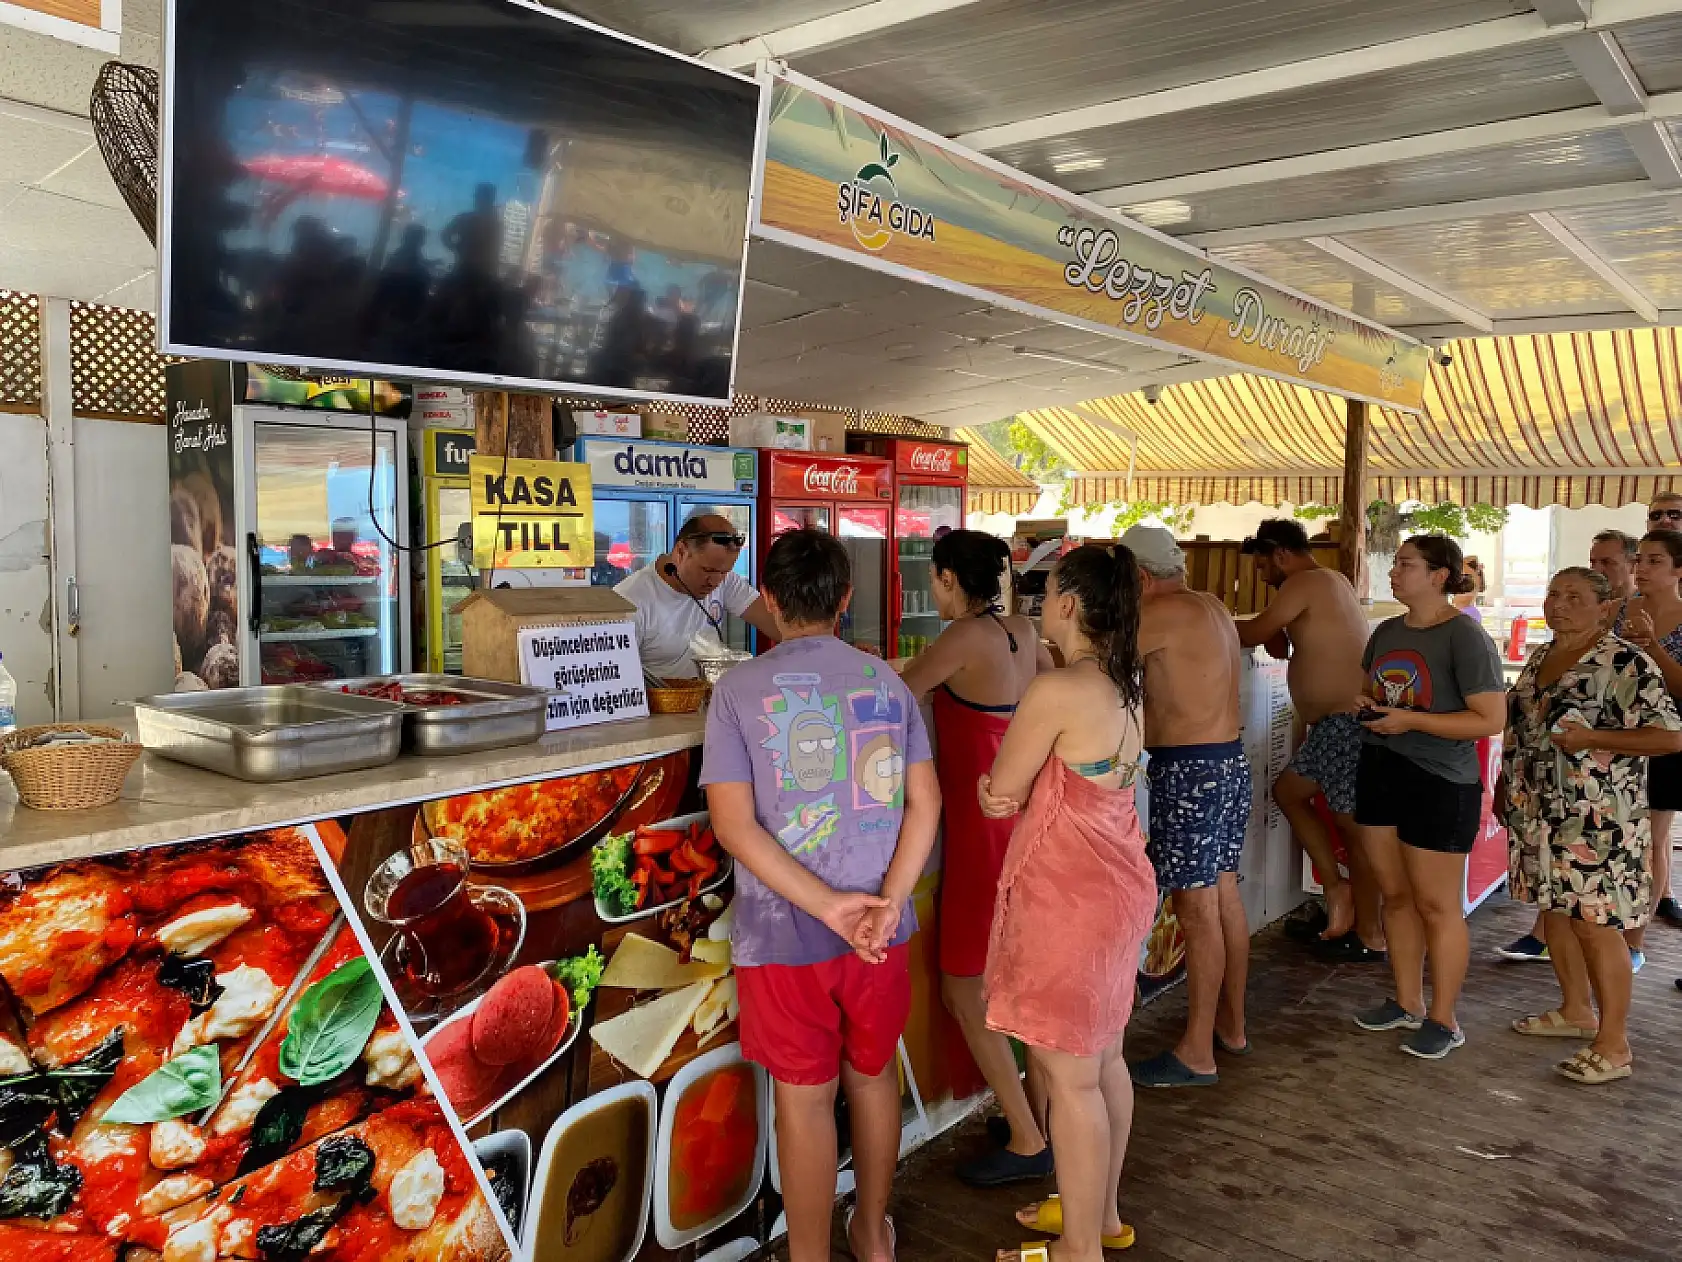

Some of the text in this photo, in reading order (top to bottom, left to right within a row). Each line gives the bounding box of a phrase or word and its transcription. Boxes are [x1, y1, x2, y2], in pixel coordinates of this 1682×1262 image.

[838, 182, 936, 241] ŞİFA GIDA
[614, 444, 708, 479] damla
[484, 474, 577, 507] KASA
[497, 522, 571, 551] TILL
[531, 631, 631, 661] Düşünceleriniz ve
[553, 660, 621, 691] görüşleriniz
[569, 694, 592, 720] için
